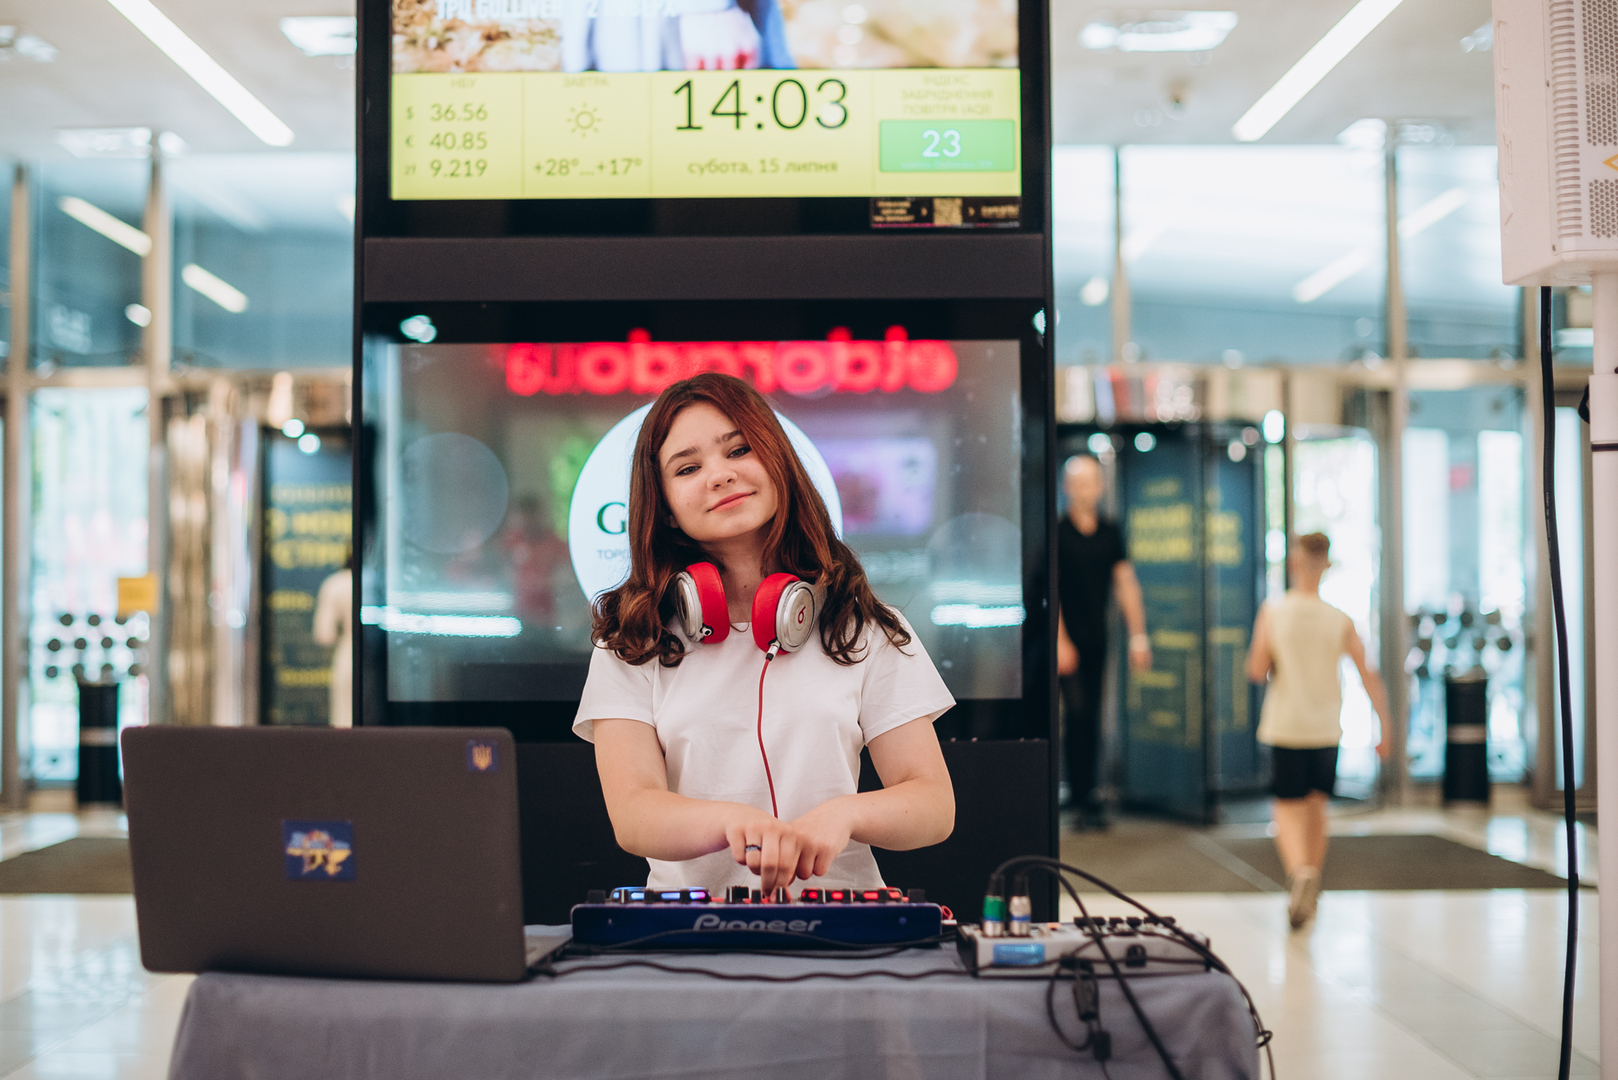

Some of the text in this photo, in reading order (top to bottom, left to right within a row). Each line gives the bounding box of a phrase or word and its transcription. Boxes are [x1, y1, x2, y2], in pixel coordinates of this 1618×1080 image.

[430, 102, 489, 122] 36.56
[674, 78, 849, 131] 14:03
[430, 131, 488, 151] 40.85
[921, 128, 962, 158] 23
[430, 158, 488, 178] 9.219
[688, 158, 839, 176] субота, 15 липня
[693, 914, 822, 932] Pioneer
